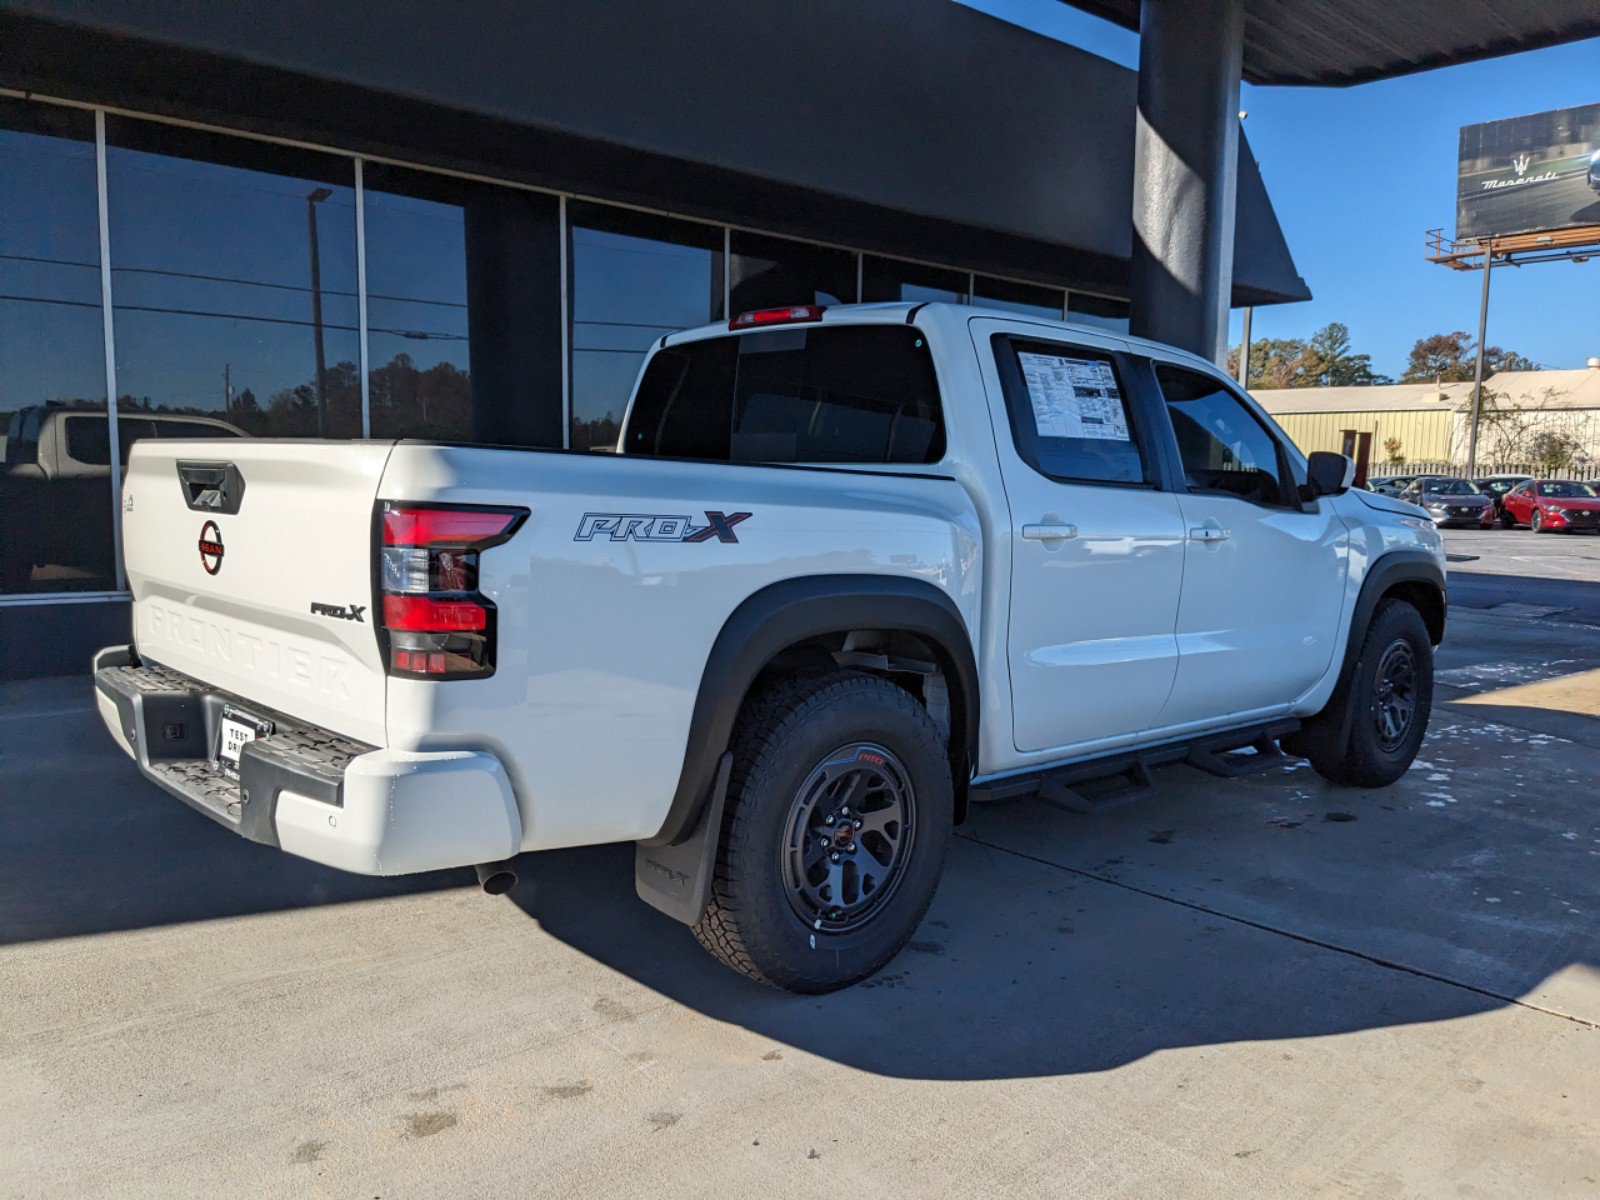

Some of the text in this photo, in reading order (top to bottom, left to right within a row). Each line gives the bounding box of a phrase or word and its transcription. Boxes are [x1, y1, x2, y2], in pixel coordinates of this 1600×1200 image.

[1482, 171, 1560, 189] Maserati
[200, 541, 222, 556] SSAN
[150, 604, 351, 701] FRONTIER
[230, 728, 248, 742] TEST
